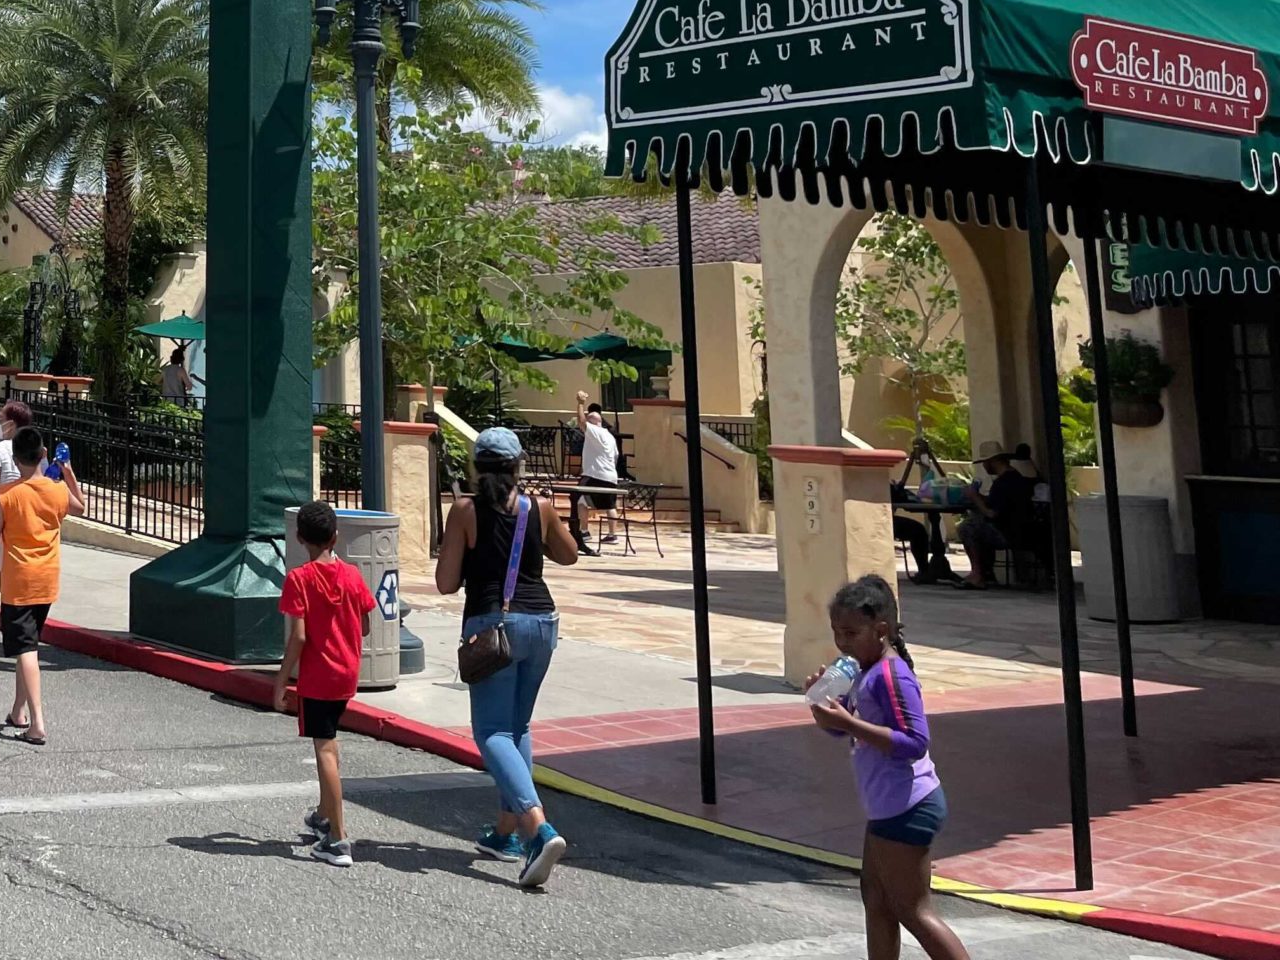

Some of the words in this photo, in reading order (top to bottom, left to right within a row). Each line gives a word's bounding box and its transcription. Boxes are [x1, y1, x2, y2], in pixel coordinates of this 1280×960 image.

[639, 21, 927, 83] RESTAURANT
[1095, 39, 1150, 80] Cafe
[1152, 48, 1176, 86] La
[1178, 53, 1248, 98] Bamba
[1095, 80, 1250, 119] RESTAURANT
